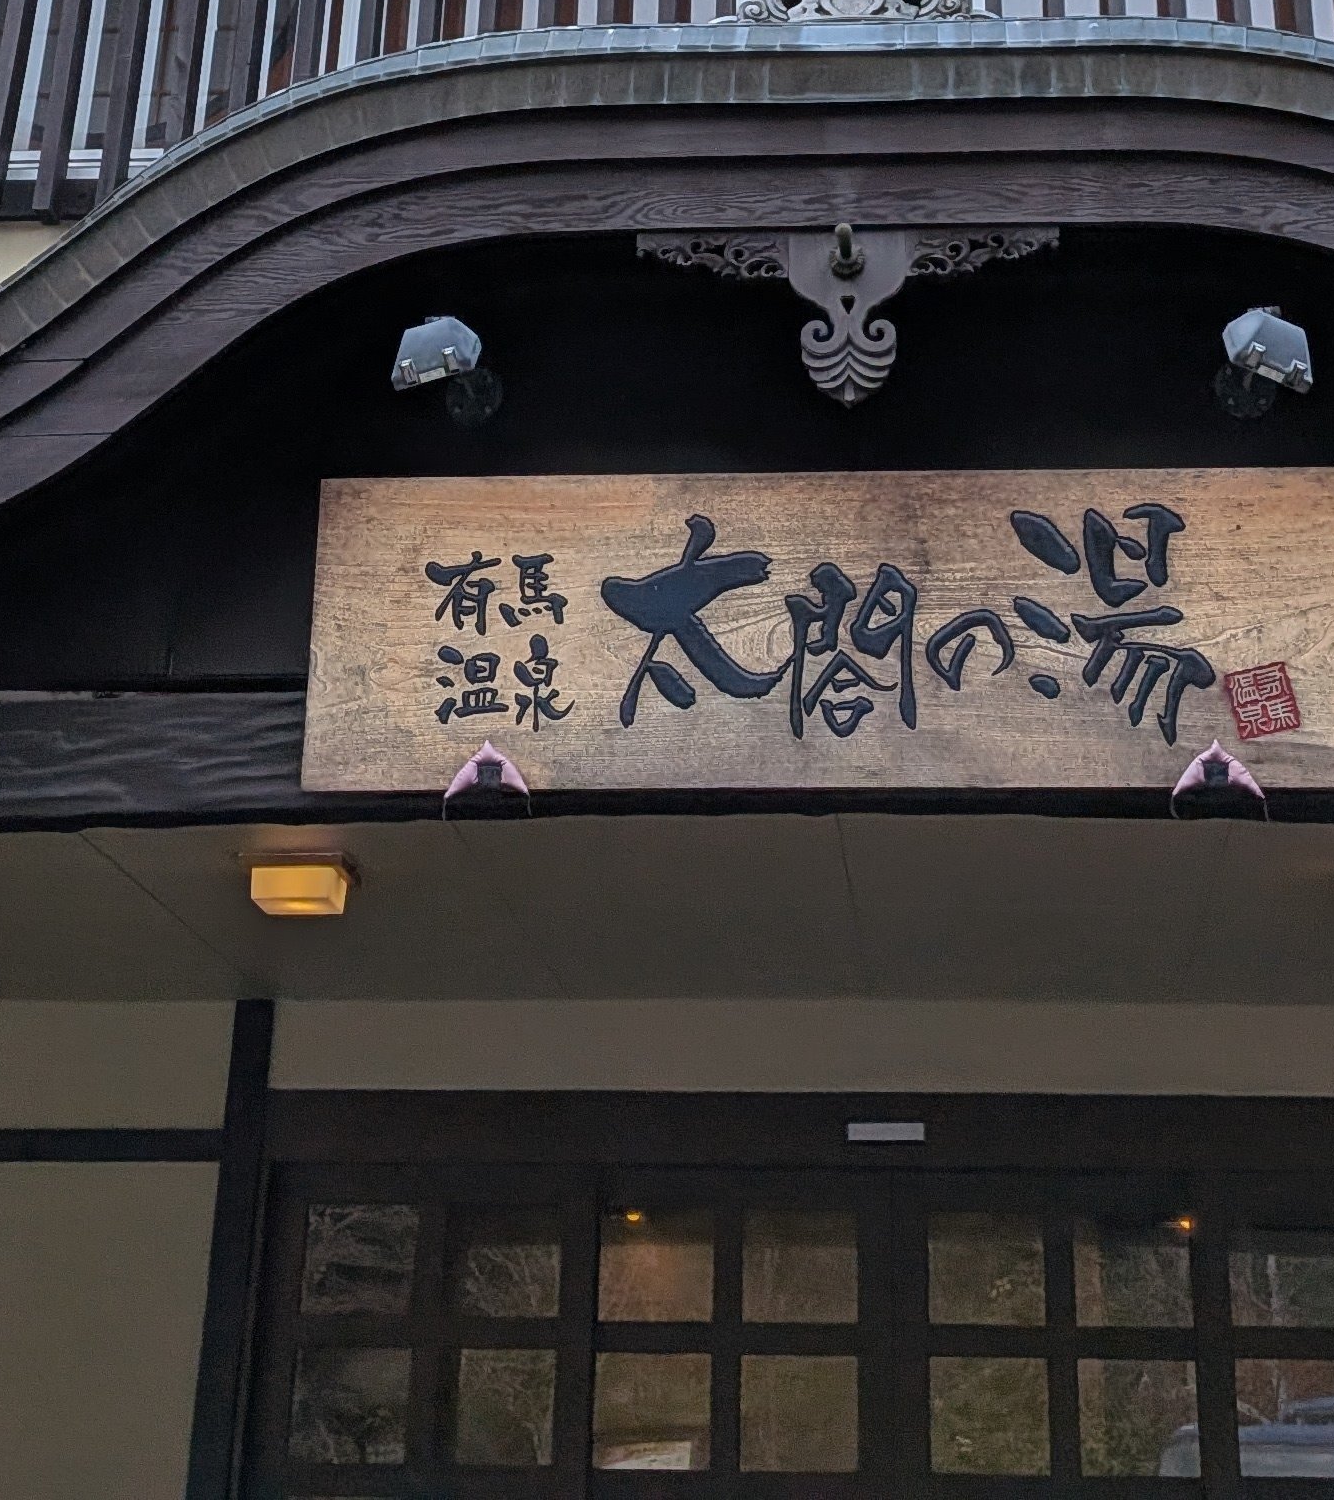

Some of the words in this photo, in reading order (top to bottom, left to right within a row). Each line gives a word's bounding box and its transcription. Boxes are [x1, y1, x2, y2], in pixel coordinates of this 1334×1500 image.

[424, 550, 569, 636] 有馬
[600, 502, 1217, 747] 太閤の湯
[433, 633, 576, 733] 温泉
